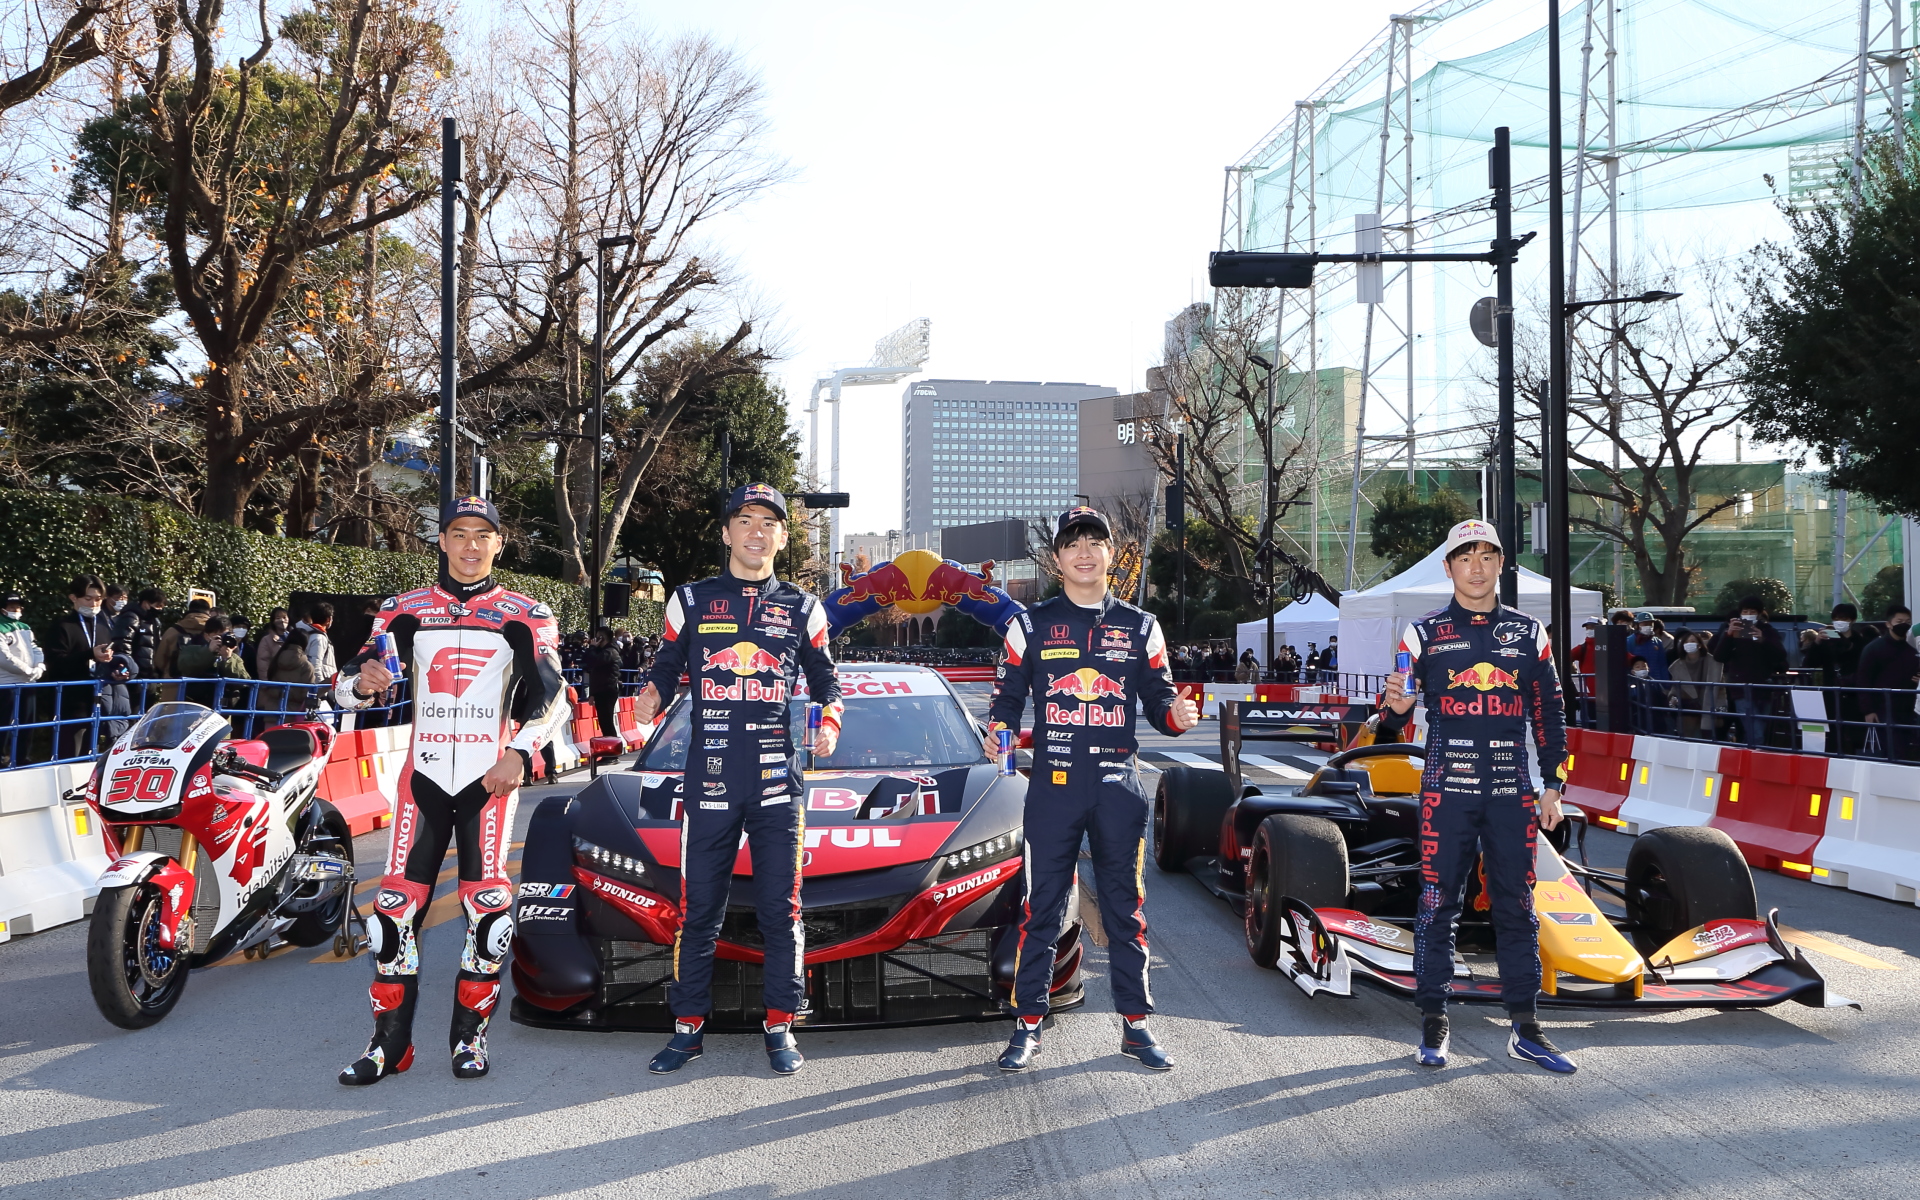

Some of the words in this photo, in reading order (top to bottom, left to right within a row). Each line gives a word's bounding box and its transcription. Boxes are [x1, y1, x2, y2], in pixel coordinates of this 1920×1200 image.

[1458, 531, 1471, 539] Red
[500, 602, 519, 613] Arai
[1437, 642, 1469, 652] YOKOHAMA
[701, 677, 743, 701] Red
[745, 678, 785, 703] Bull
[421, 701, 494, 719] idemitsu
[1045, 702, 1086, 726] Red
[1088, 704, 1126, 727] Bull
[1246, 709, 1341, 720] ADVAN
[1440, 694, 1483, 716] Red
[1487, 695, 1523, 716] Bull
[542, 704, 569, 742] idemitsu
[418, 733, 494, 743] HONDA
[772, 768, 787, 776] EKC
[105, 766, 178, 806] 30
[188, 786, 212, 799] GIVI
[1421, 791, 1442, 838] Red
[393, 801, 415, 876] HONDA
[484, 805, 498, 880] HONDA
[236, 846, 289, 909] idemitsu
[946, 868, 1001, 898] DUNLOP
[600, 882, 657, 908] DUNLOP
[1724, 932, 1753, 946] POWER
